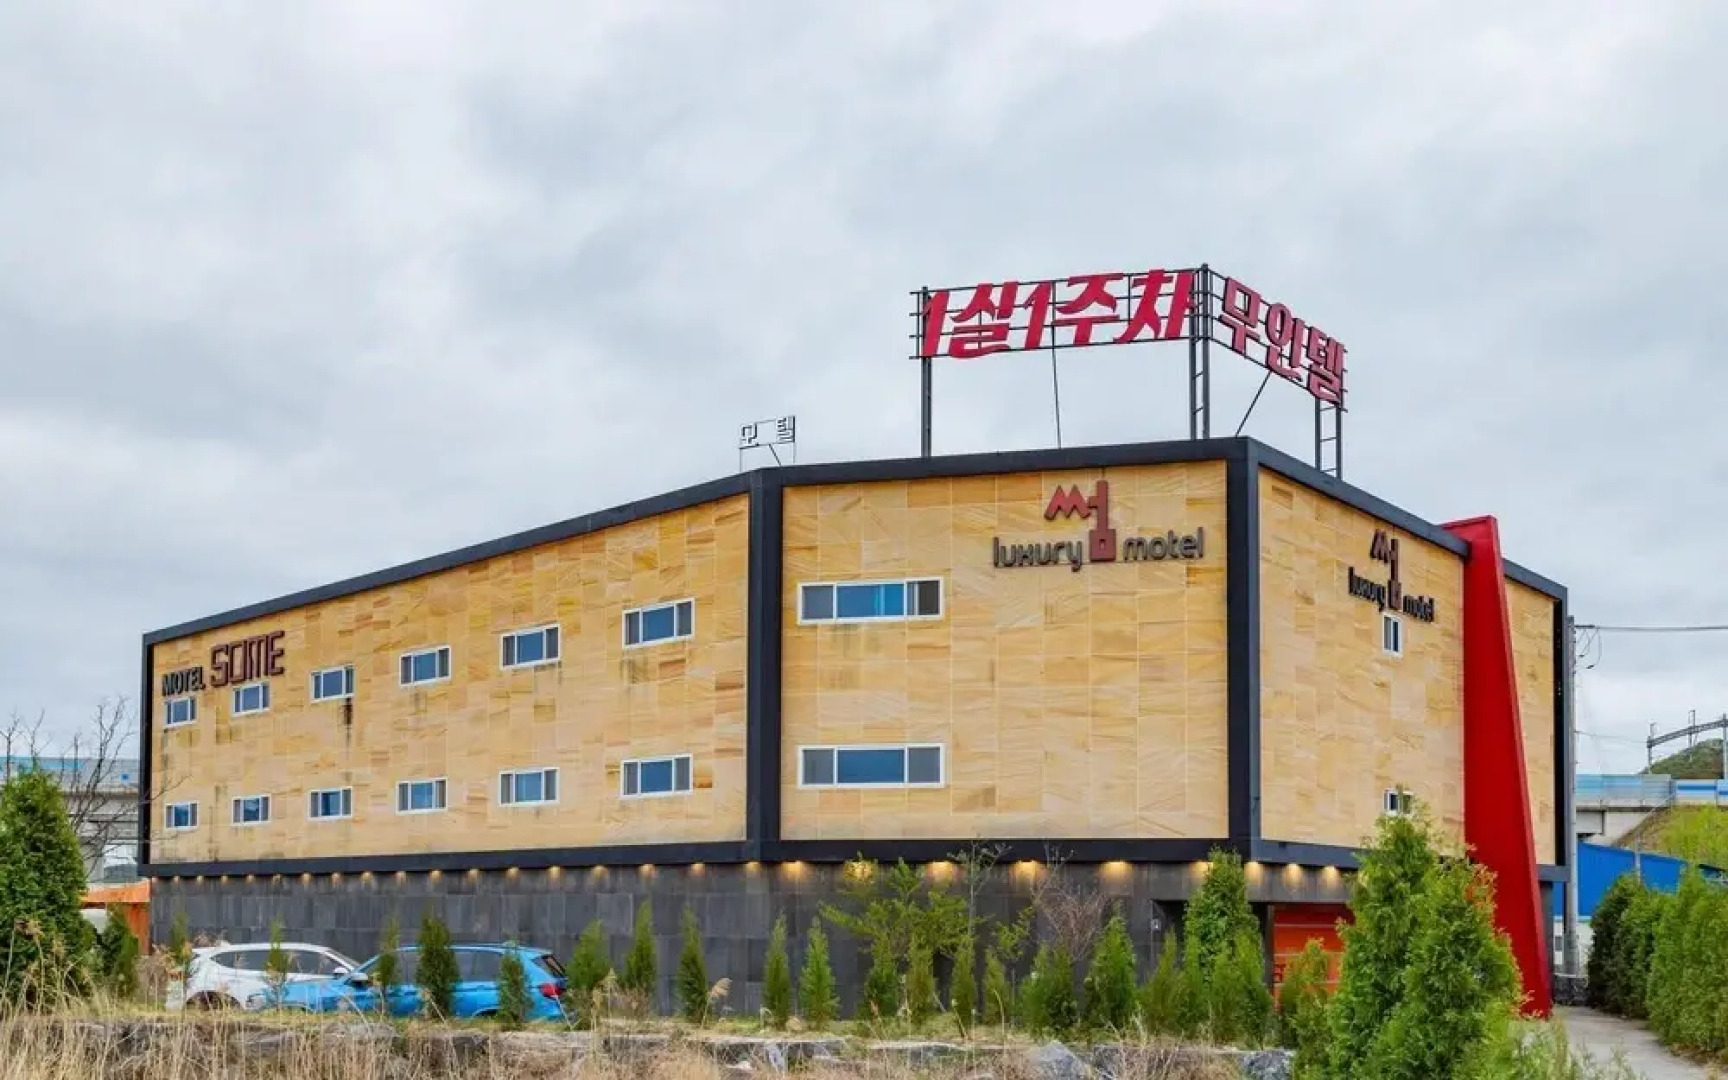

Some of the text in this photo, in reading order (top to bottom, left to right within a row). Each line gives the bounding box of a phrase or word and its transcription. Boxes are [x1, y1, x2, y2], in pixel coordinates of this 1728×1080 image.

[1218, 276, 1345, 405] 무인텔
[993, 526, 1204, 573] luxury motel
[1043, 479, 1117, 562] 썸
[162, 630, 285, 697] MOTEL SOME
